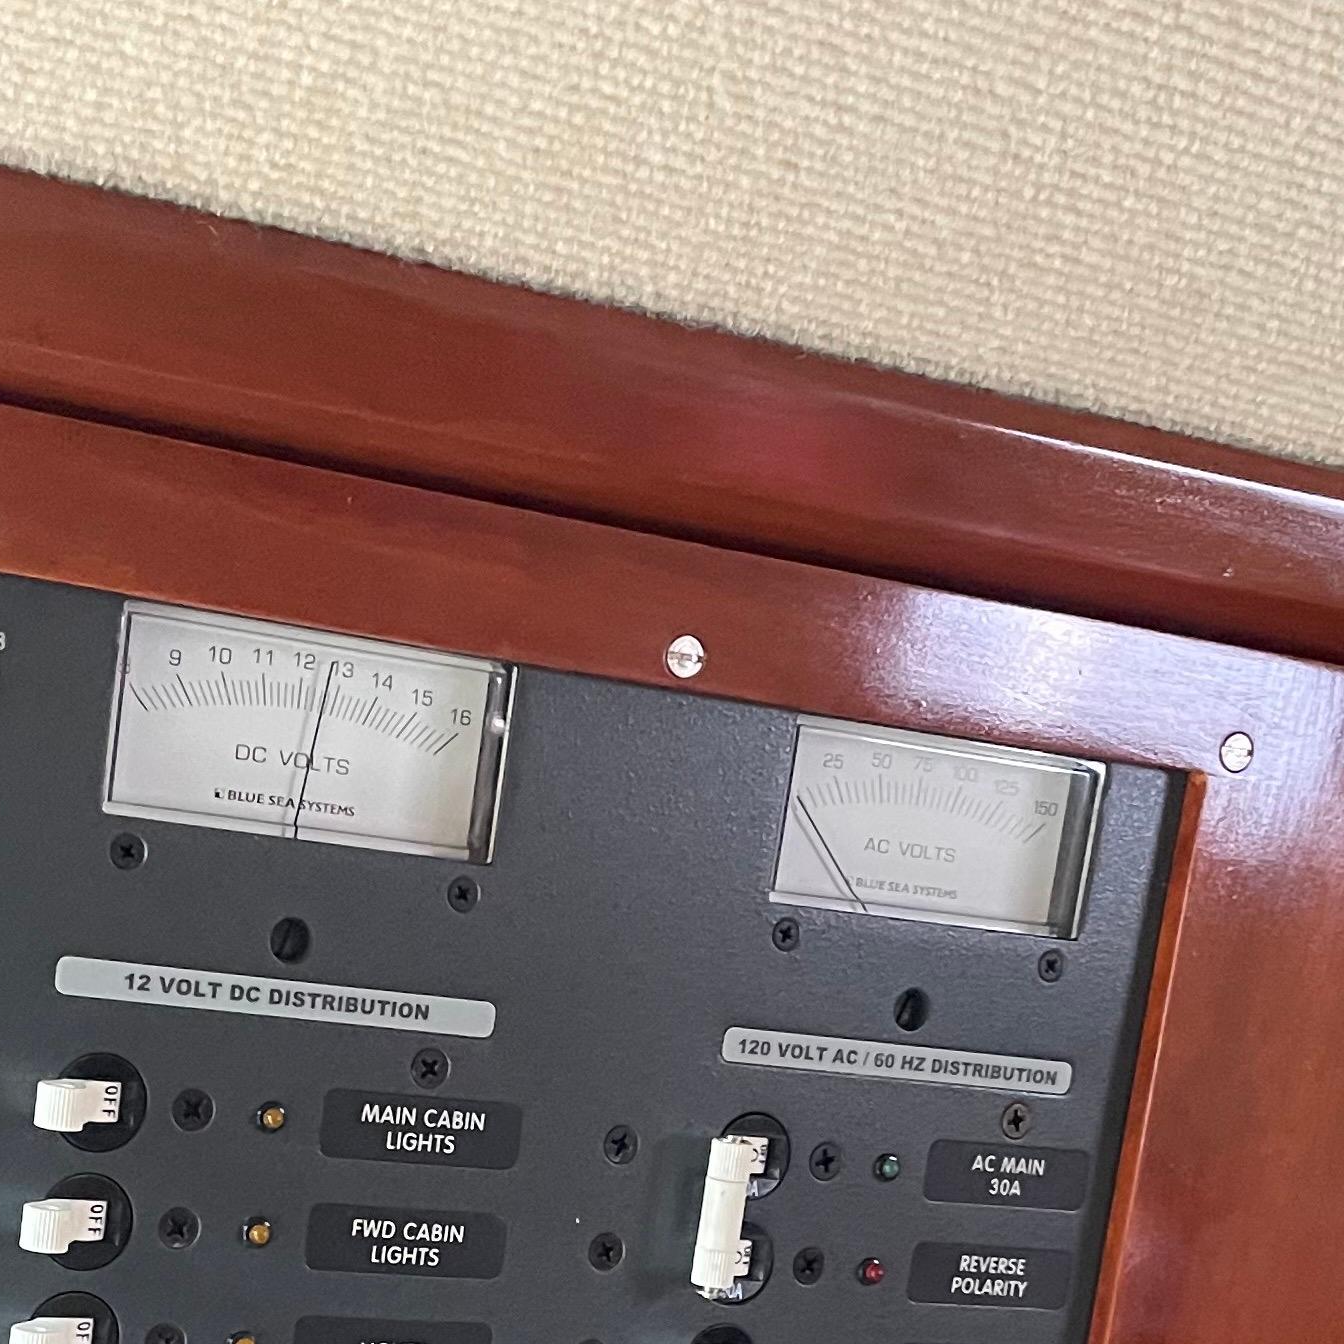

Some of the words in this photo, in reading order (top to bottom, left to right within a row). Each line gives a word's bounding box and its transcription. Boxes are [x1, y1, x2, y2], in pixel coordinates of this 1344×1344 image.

[169, 649, 182, 666] 9
[209, 646, 232, 665] 10
[253, 648, 273, 666] 11
[294, 652, 316, 670] 12
[334, 661, 354, 678] 13
[372, 673, 393, 690] 14
[412, 689, 433, 707] 15
[450, 709, 471, 726] 16
[235, 744, 266, 764] DC
[280, 750, 350, 776] VOLTS
[823, 753, 844, 769] 25
[871, 754, 891, 769] 50
[914, 757, 934, 772] 75
[228, 790, 264, 804] BLUE
[268, 796, 295, 808] SEA
[299, 800, 354, 816] SYSTEMS
[1035, 800, 1058, 816] 150
[864, 838, 890, 854] AC
[899, 843, 955, 863] VOLTS
[856, 877, 884, 890] BLUE
[888, 881, 909, 893] SEA
[913, 885, 957, 899] SYSTEMS
[124, 973, 151, 992] 12
[160, 976, 222, 1000] VOLT
[230, 984, 260, 1003] DC
[268, 988, 430, 1021] DISTRIBUTION
[738, 1039, 771, 1056] 120
[777, 1043, 827, 1062] VOLT
[832, 1048, 859, 1065] AC
[874, 1053, 895, 1069] 60
[901, 1056, 927, 1071] HZ
[931, 1059, 1058, 1086] DISTRIBUTION
[102, 1085, 119, 1119] OFF
[361, 1103, 417, 1127] MAIN
[423, 1108, 486, 1131] CABIN
[385, 1130, 456, 1154] LIGHTS
[971, 1155, 996, 1173] AC
[999, 1158, 1046, 1176] MAIN
[989, 1178, 1021, 1196] 30A
[88, 1203, 104, 1236] OFF
[351, 1219, 397, 1239] FWD
[403, 1221, 465, 1244] CABIN
[370, 1244, 440, 1267] LIGHTS
[959, 1255, 1026, 1276] REVERSE
[950, 1277, 1028, 1298] POLARITY
